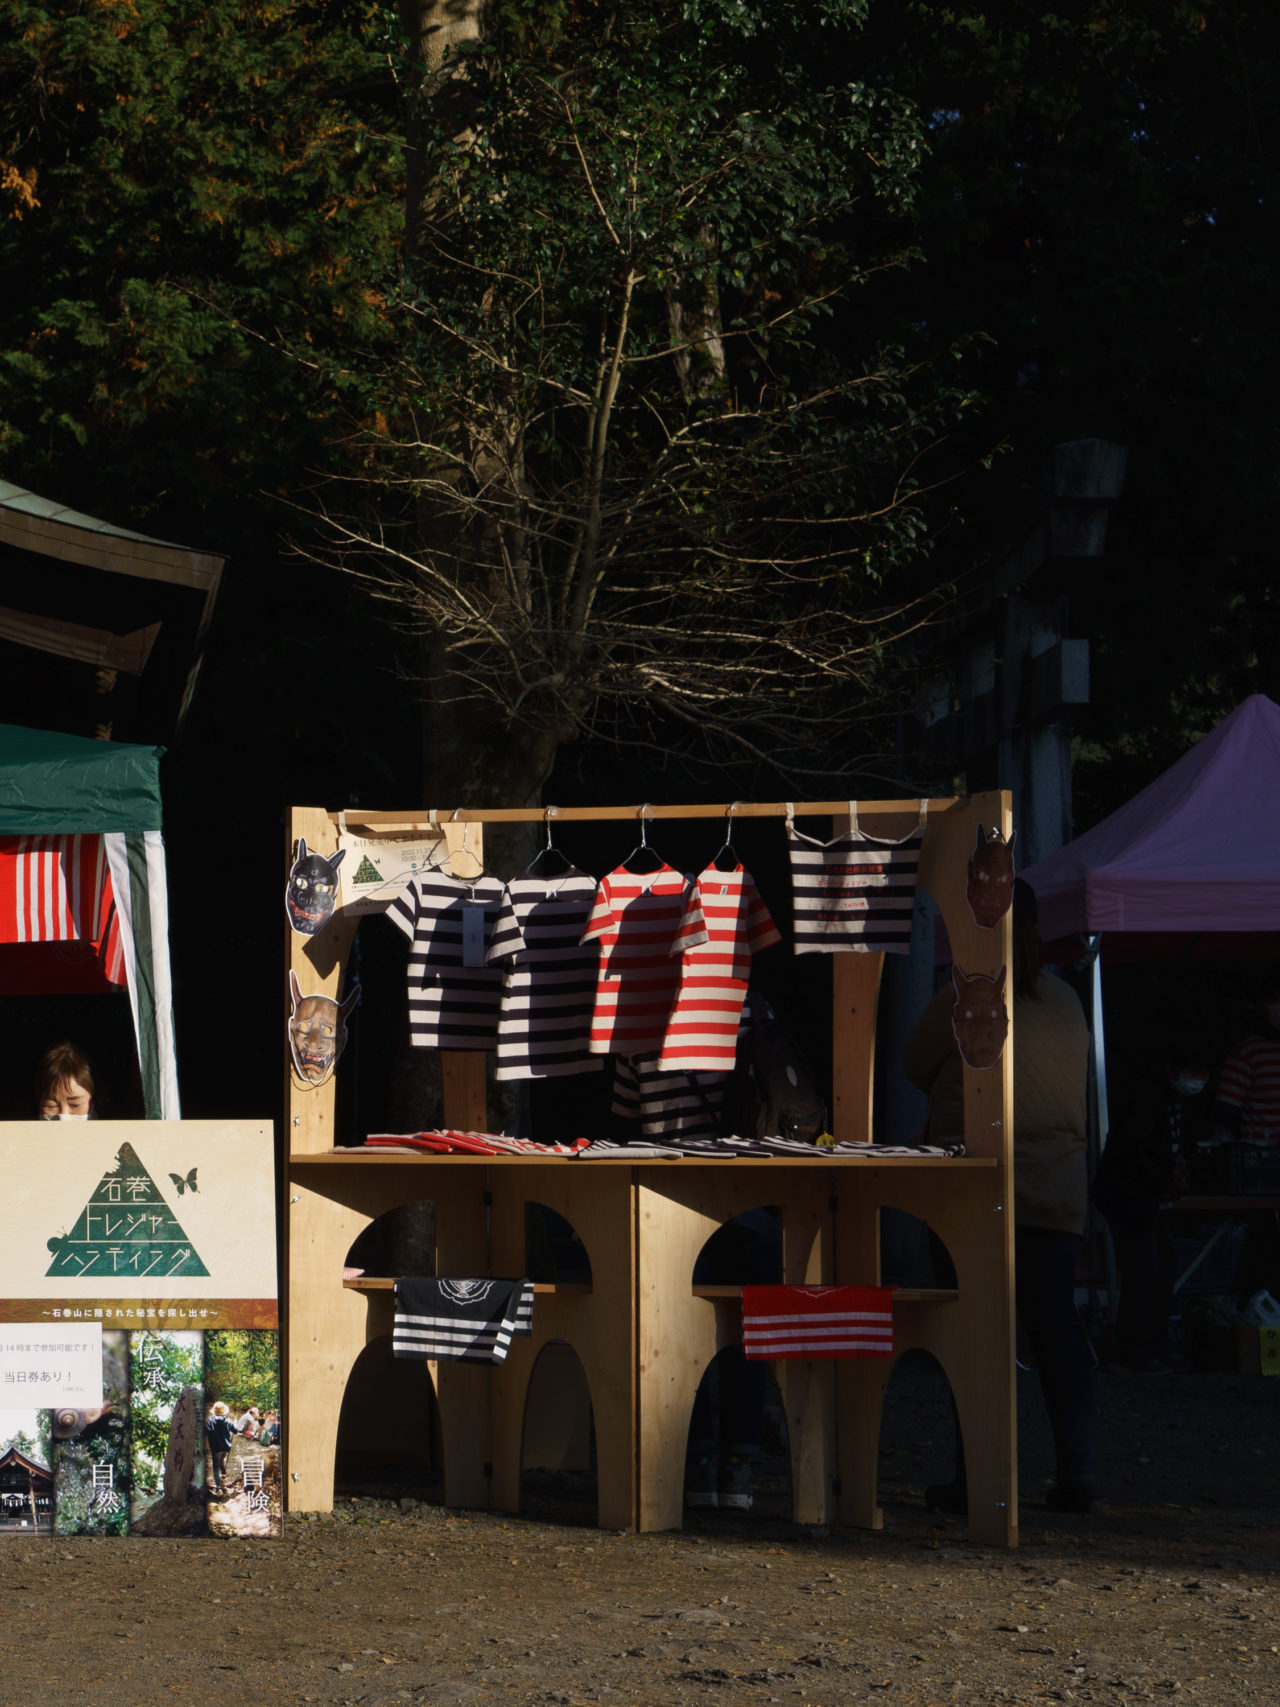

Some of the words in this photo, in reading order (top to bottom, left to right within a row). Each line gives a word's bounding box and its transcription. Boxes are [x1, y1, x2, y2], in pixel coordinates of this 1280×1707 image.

[101, 1176, 151, 1201] 石巻
[86, 1204, 180, 1241] トレジャー
[60, 1248, 191, 1277] ハンティング
[3, 1370, 72, 1384] 当日券あり！
[138, 1335, 170, 1388] 伝承
[91, 1459, 120, 1514] 自然
[240, 1458, 271, 1514] 冒険
